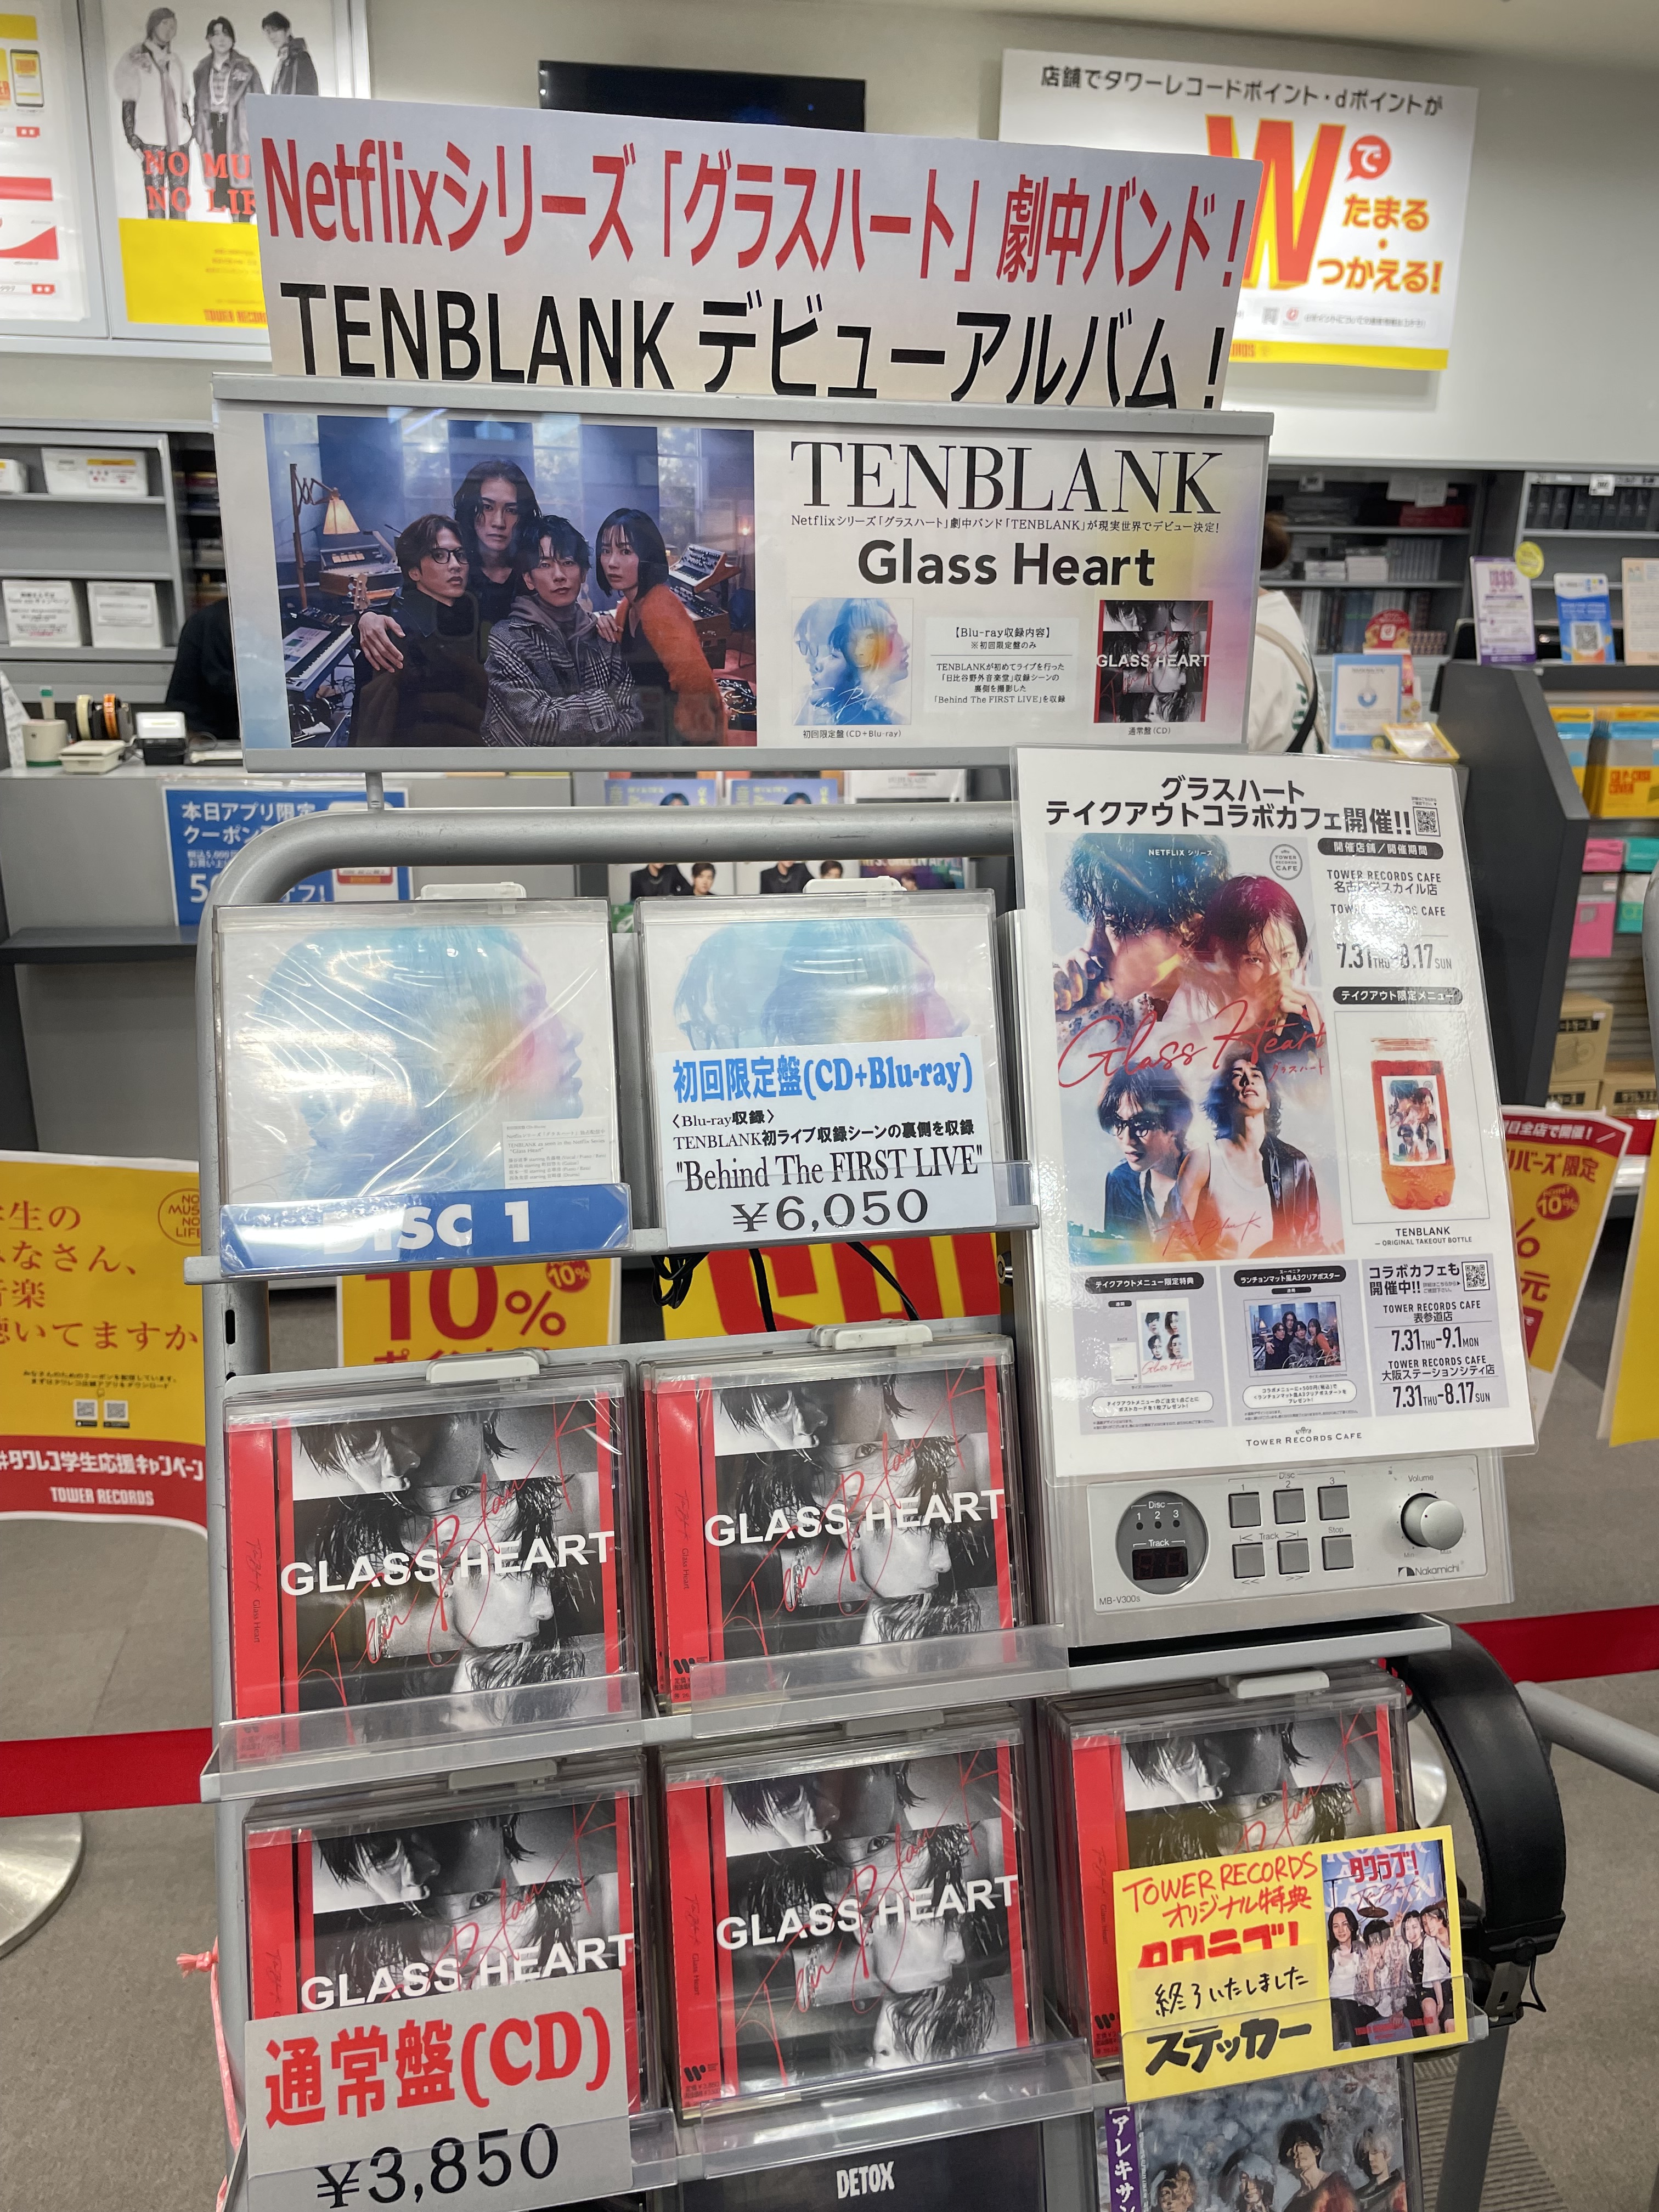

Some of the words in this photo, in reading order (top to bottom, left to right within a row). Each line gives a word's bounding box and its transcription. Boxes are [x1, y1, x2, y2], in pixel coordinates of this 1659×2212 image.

[143, 150, 190, 176] NO
[1356, 146, 1383, 173] で
[145, 185, 191, 212] NO
[1342, 194, 1429, 232] たまる
[1318, 256, 1443, 295] つかえる!
[280, 282, 675, 390] TENBLANK
[791, 441, 1223, 515] TENBLANK
[858, 537, 998, 585] Glass
[1013, 542, 1156, 586] Heart
[1097, 654, 1150, 668] GLASS
[1156, 654, 1210, 668] HEART
[1160, 774, 1305, 802] グラスハート
[182, 800, 316, 823] 本日アプリ限定
[1046, 800, 1411, 836] テイクアウトコラボカフェ開催!!
[184, 825, 273, 844] クーポン
[1327, 870, 1363, 879] TOWER
[1367, 870, 1414, 881] RECORDS
[1417, 872, 1442, 883] CAFE
[1421, 906, 1446, 917] CAFE
[1341, 990, 1454, 1001] テイクアウト限定メニュー
[1058, 1014, 1207, 1088] Glass
[673, 1052, 973, 1104] 初回限定盤(CD+Blu-ray)
[673, 1119, 975, 1151] TENBLANK初ライブ収録シーンの裏側を収録
[775, 1154, 824, 1186] The
[830, 1148, 907, 1183] FIRST
[182, 1194, 200, 1204] NO
[732, 1188, 929, 1233] ¥6,050
[0, 1200, 81, 1232] 生の
[182, 1216, 200, 1227] NO
[505, 1200, 530, 1243] 1
[1395, 1226, 1451, 1237] TENBLANK
[0, 1242, 136, 1276] なさん、
[1369, 1262, 1460, 1279] コラボカフェも
[0, 1278, 46, 1309] 楽
[1369, 1280, 1421, 1296] 開催中!!
[365, 1266, 567, 1342] 10%
[1383, 1304, 1414, 1314] TOWER
[1417, 1301, 1457, 1312] RECORDS
[1460, 1300, 1481, 1310] CAFE
[1413, 1311, 1453, 1324] 表参道店
[1381, 1363, 1496, 1381] 大阪ステーションシティ店
[1388, 1359, 1419, 1369] TOWER
[1422, 1357, 1462, 1368] RECORDS
[1465, 1355, 1487, 1364] CAFE
[1279, 1471, 1295, 1480] Disc
[1285, 1480, 1291, 1488] 2
[1329, 1477, 1335, 1485] 3
[1408, 1474, 1434, 1483] Volume
[49, 1486, 95, 1504] TOWER
[96, 1488, 155, 1506] RECORDS
[1148, 1500, 1166, 1510] Disc
[704, 1502, 849, 1548] GLASS
[865, 1488, 1006, 1532] HEART
[1136, 1512, 1142, 1520] 1
[1154, 1510, 1161, 1519] 2
[1172, 1509, 1179, 1518] 3
[1148, 1538, 1170, 1548] Track
[1259, 1532, 1280, 1541] Track
[1328, 1526, 1344, 1535] Stop
[280, 1548, 445, 1597] GLASS
[459, 1531, 616, 1580] HEART
[1415, 1564, 1460, 1576] Nakamichi
[1099, 1594, 1141, 1606] MB-V300s
[1123, 1870, 1216, 1913] TOWER
[1220, 1850, 1318, 1891] RECORDS
[715, 1899, 864, 1951] GLASS
[877, 1875, 1019, 1928] HEART
[1162, 1884, 1312, 1928] オリジナル特典
[301, 1958, 464, 2010] GLASS
[478, 1933, 635, 1990] HEART
[1154, 1966, 1308, 2017] 終了いたしました
[1145, 2018, 1312, 2076] ステッカー
[264, 2006, 611, 2130] 通常盤(CD)
[314, 2123, 559, 2209] ¥3,850
[836, 2161, 896, 2199] DETOX
